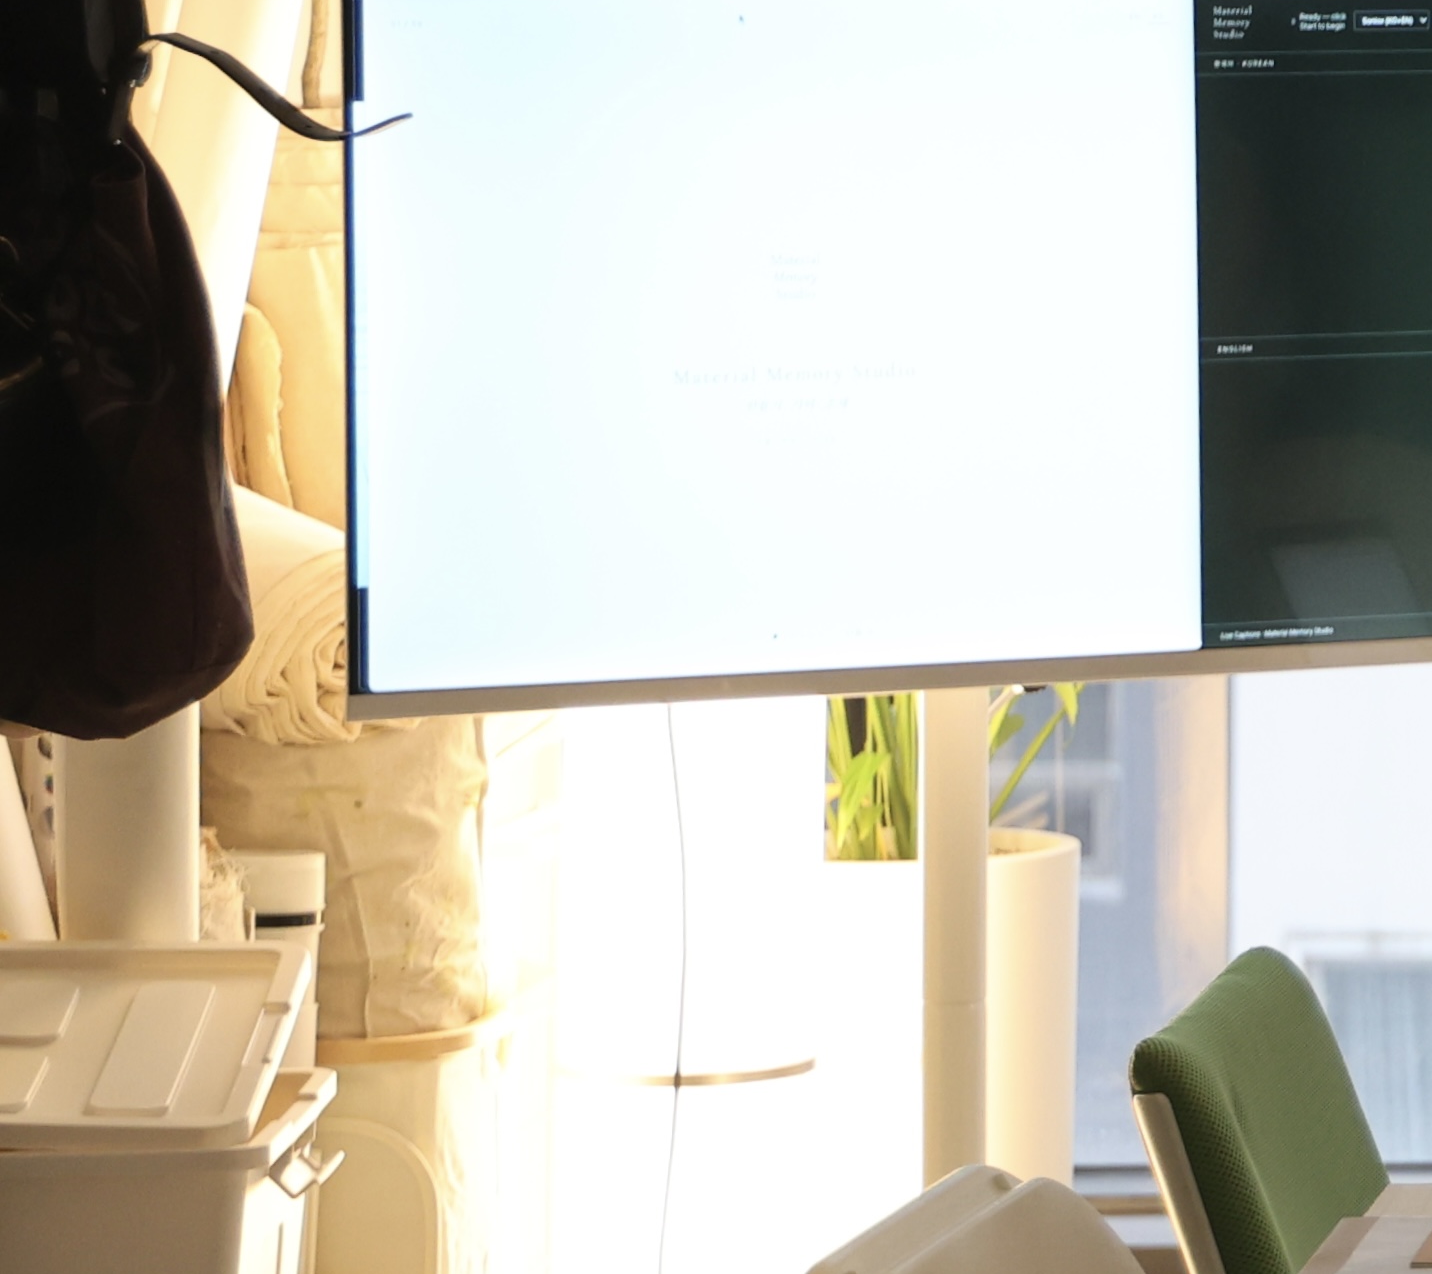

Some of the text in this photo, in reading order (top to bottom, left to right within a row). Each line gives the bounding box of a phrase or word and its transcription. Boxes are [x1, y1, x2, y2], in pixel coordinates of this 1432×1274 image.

[1213, 5, 1252, 16] Material
[1213, 18, 1251, 29] Memory
[1213, 29, 1245, 39] Studio
[1216, 344, 1253, 354] ENGLISH
[672, 361, 917, 386] Material Memory Studio
